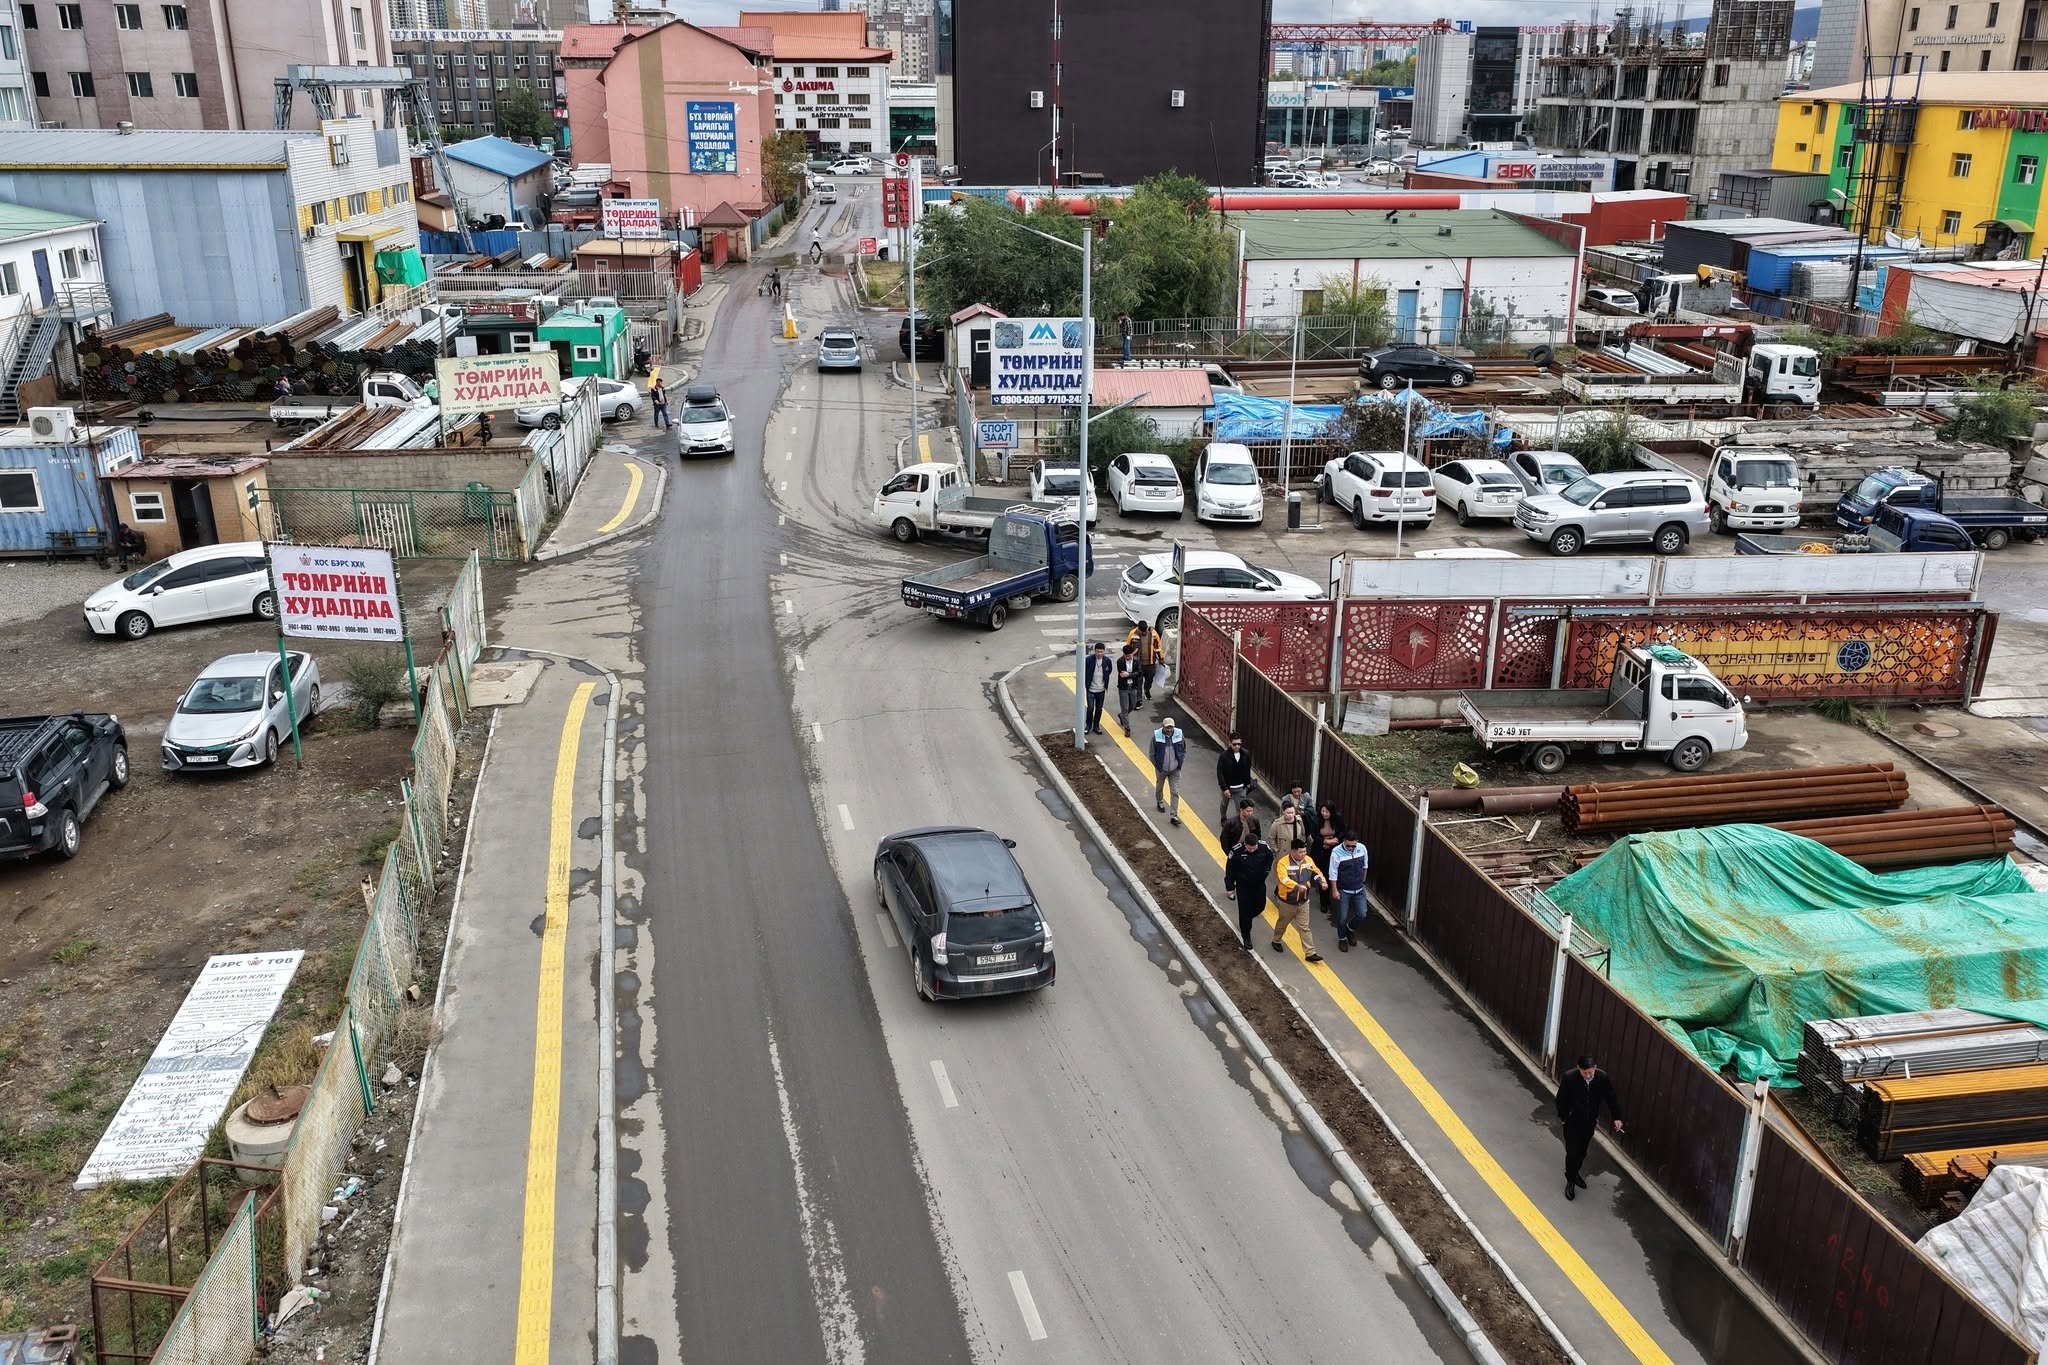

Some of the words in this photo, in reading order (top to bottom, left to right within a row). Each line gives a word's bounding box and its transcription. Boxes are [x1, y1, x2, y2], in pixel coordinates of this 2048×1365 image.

[1519, 25, 1567, 34] BUSINES
[796, 82, 834, 90] AKUMA
[605, 208, 656, 218] ТӨМРИЙН
[1000, 352, 1082, 370] ТӨМРИЙН
[454, 365, 543, 385] ТӨМРИЙН
[454, 382, 551, 401] ХУДАЛДАА
[1001, 396, 1045, 404] 9900-0206
[984, 433, 1011, 441] ЗААЛ
[283, 571, 387, 594] ТӨМРИЙН
[284, 597, 394, 620] ХУДАЛДАА
[1494, 727, 1516, 736] 92-49
